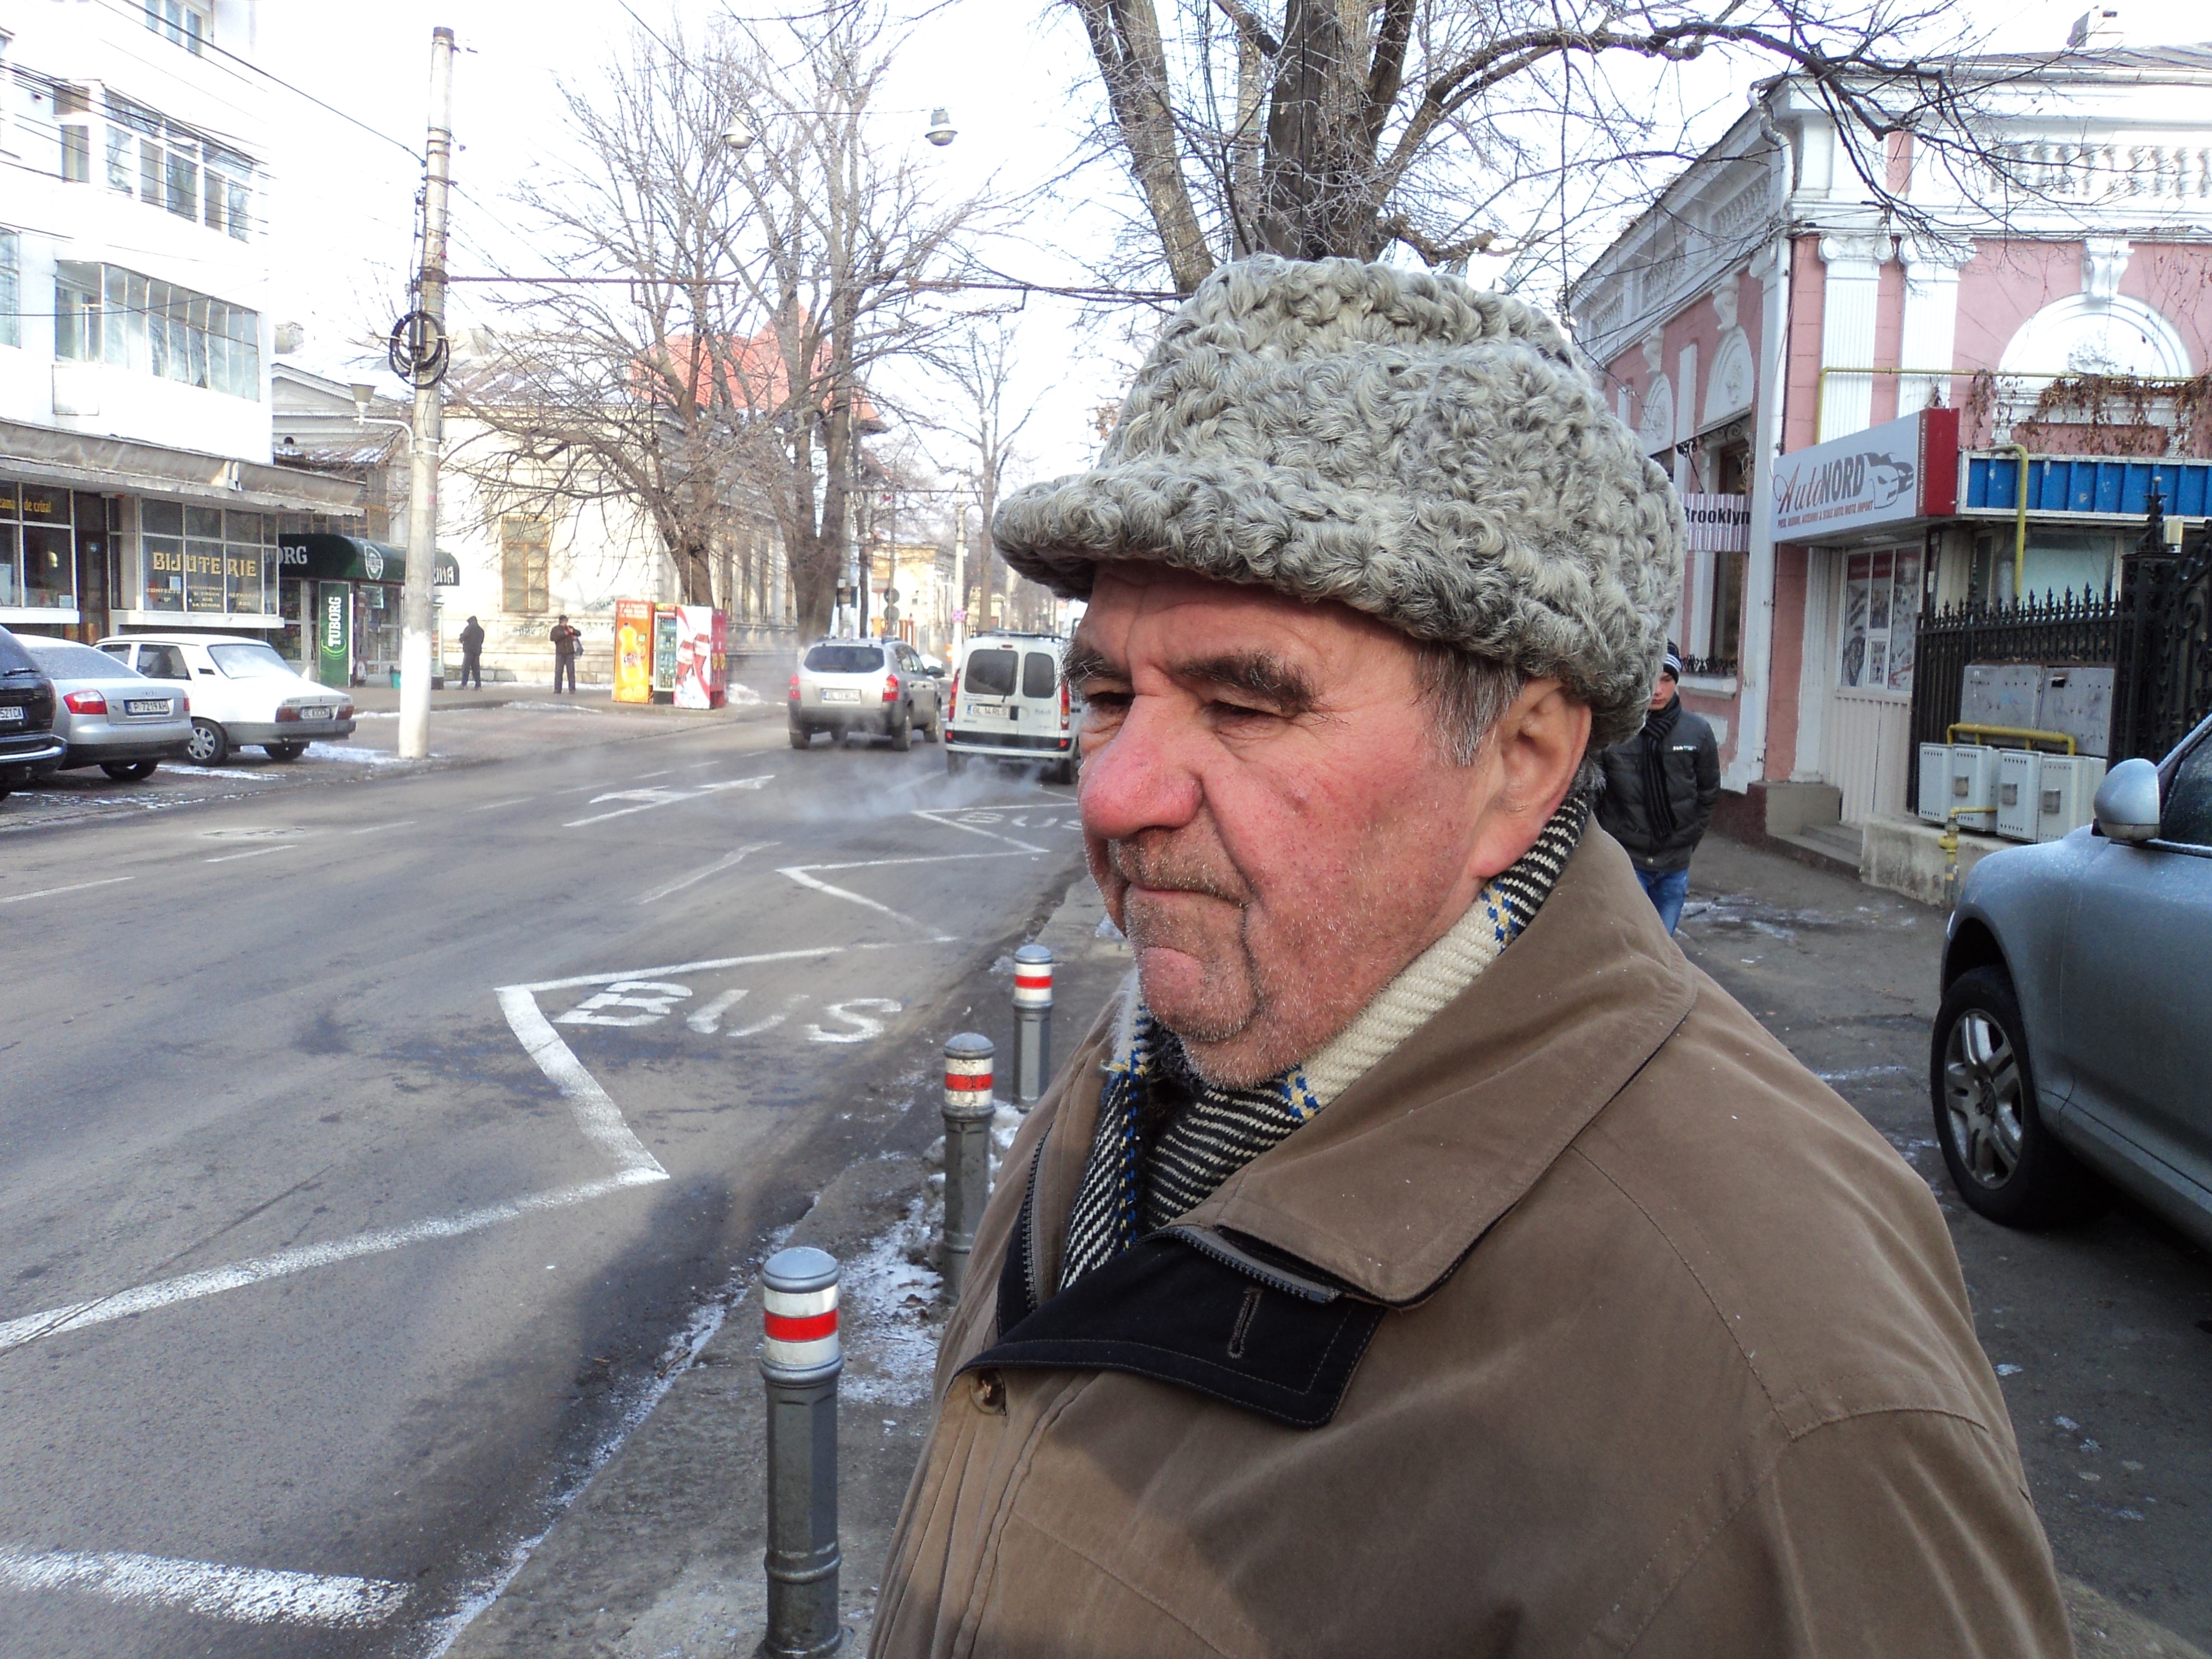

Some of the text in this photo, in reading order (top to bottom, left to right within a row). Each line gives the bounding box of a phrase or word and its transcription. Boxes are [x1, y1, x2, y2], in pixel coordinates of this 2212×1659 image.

[23, 498, 32, 511] de
[153, 552, 257, 577] BIJUTERIE
[328, 597, 341, 647] TUBORG
[552, 981, 902, 1042] BUS
